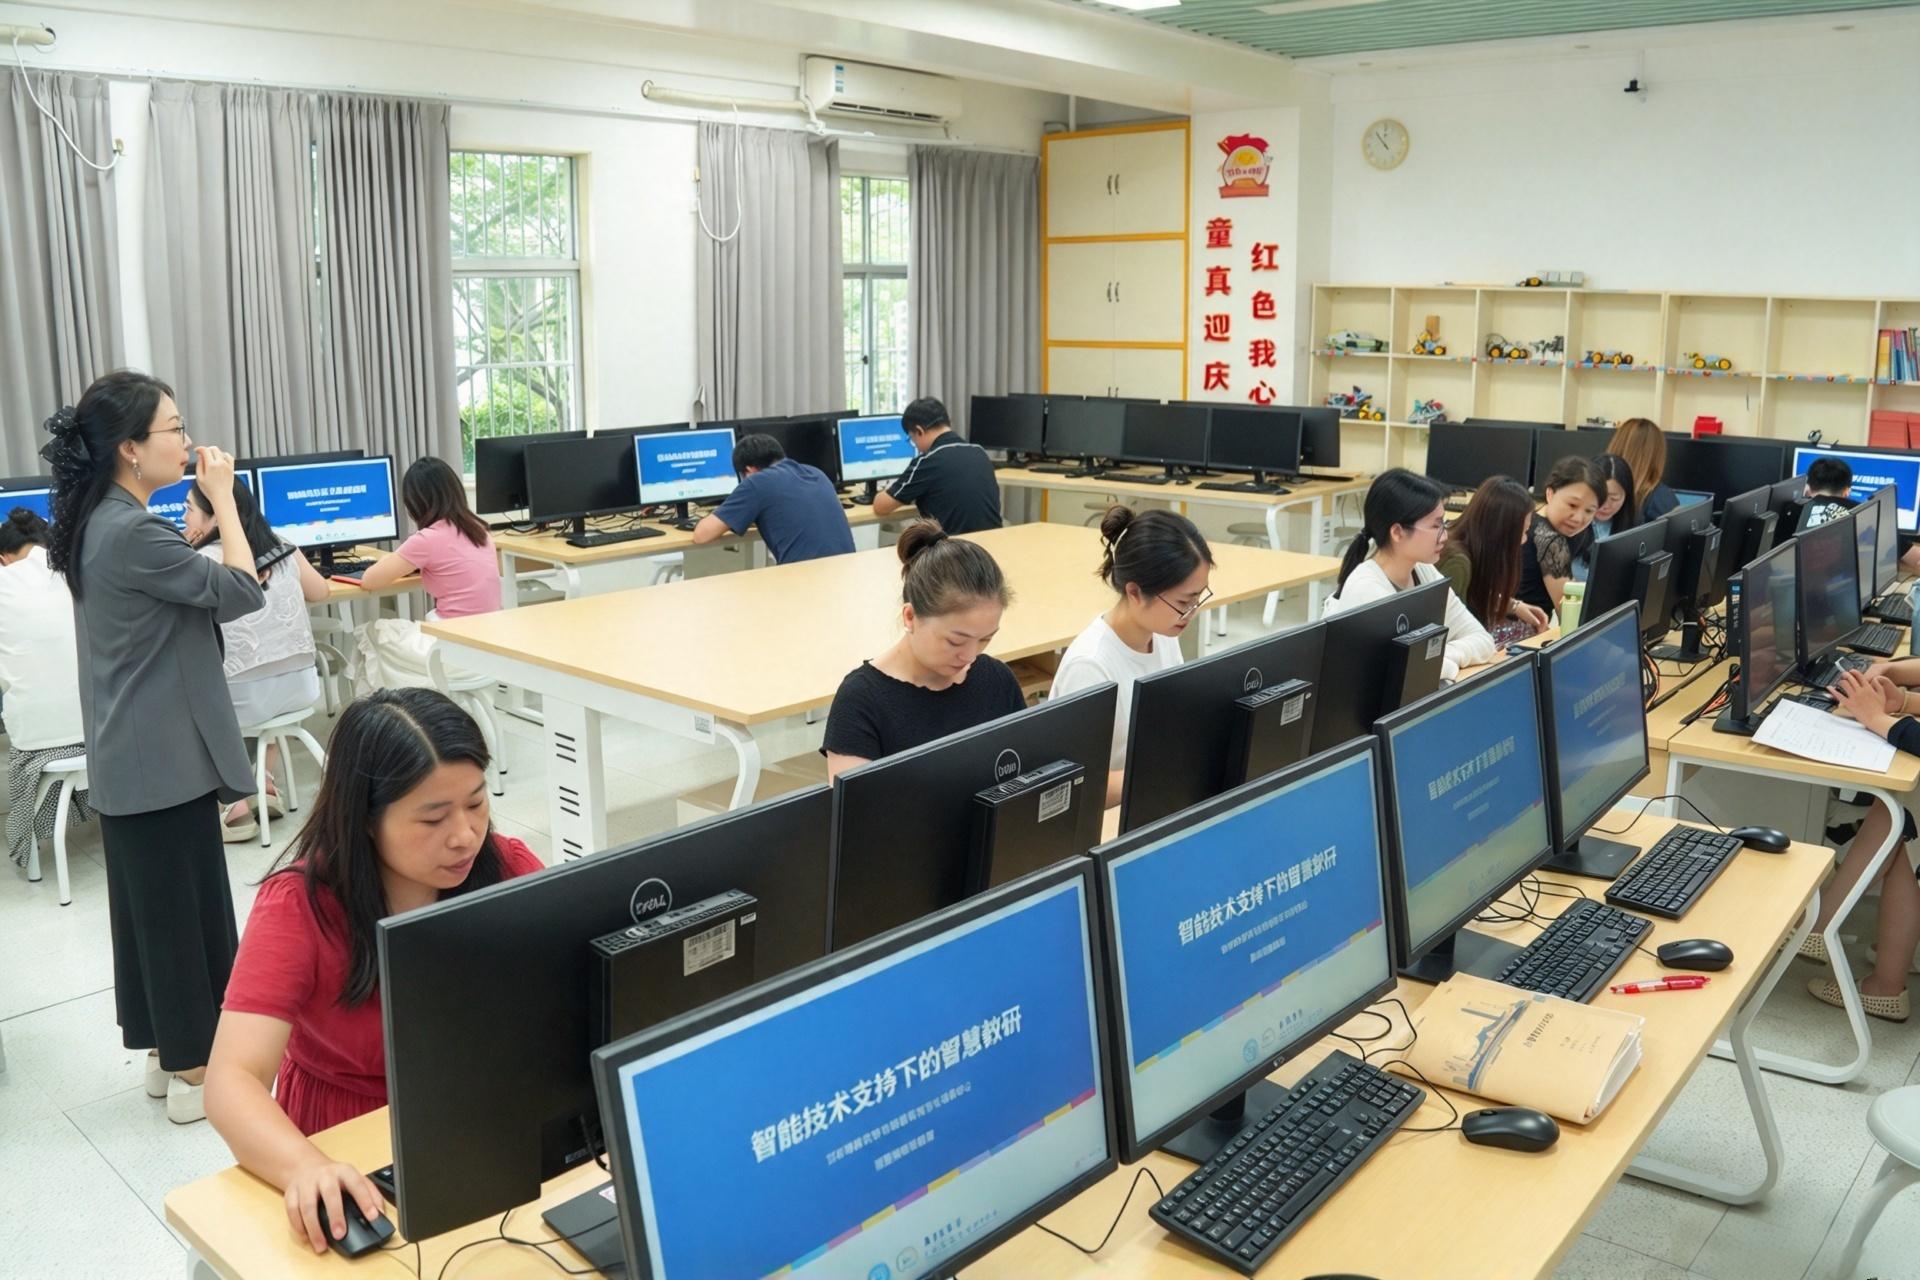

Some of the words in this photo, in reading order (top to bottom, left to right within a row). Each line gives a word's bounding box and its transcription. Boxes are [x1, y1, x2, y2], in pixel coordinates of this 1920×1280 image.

[1204, 217, 1233, 391] 童真迎庆
[1249, 243, 1279, 406] 红色我心
[751, 1005, 1021, 1164] 智能技术支持下的智慧教研
